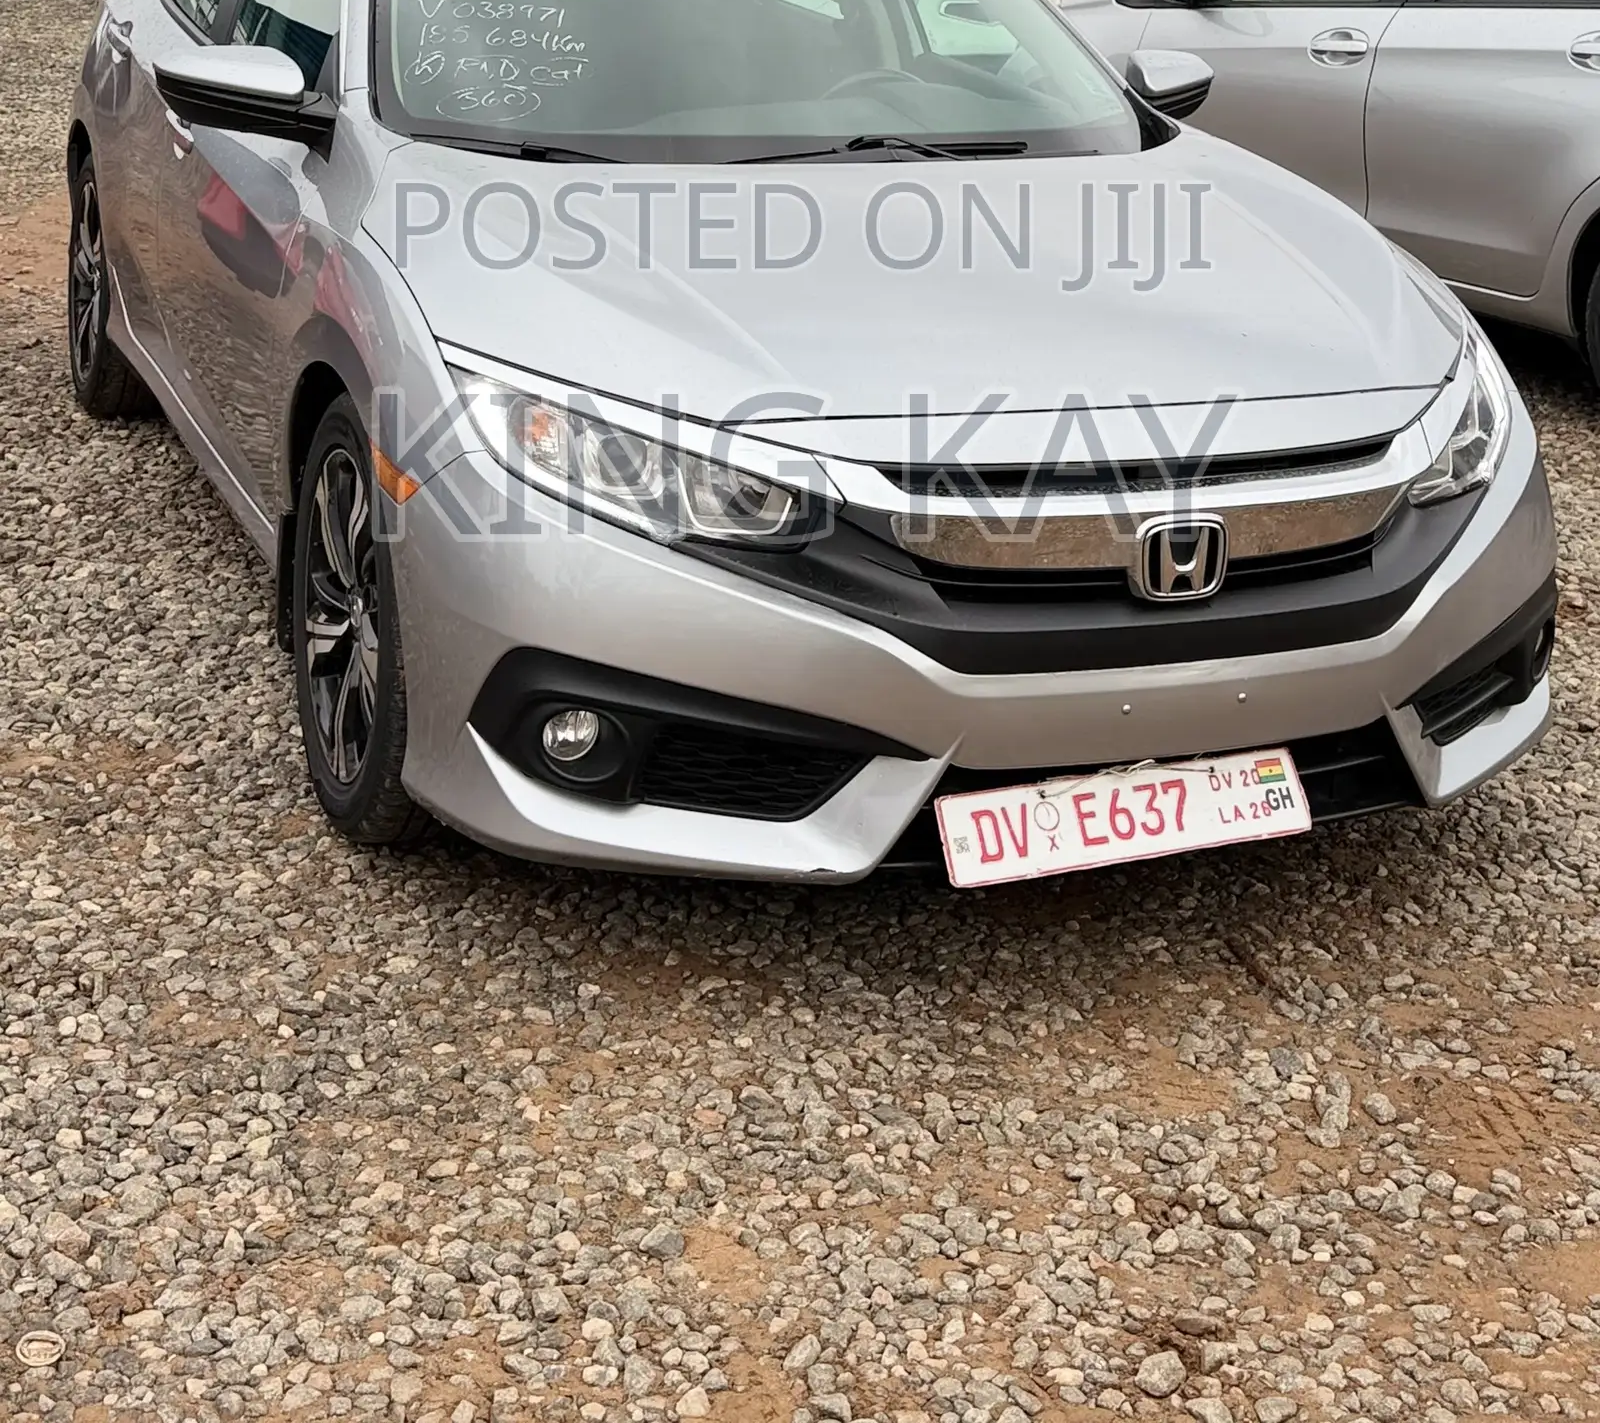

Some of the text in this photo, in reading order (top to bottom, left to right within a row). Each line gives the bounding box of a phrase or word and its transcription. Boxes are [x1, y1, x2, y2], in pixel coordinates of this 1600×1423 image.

[1208, 771, 1232, 792] DV
[1265, 786, 1295, 811] GH
[970, 778, 1188, 864] DV E637
[1218, 804, 1246, 824] LA
